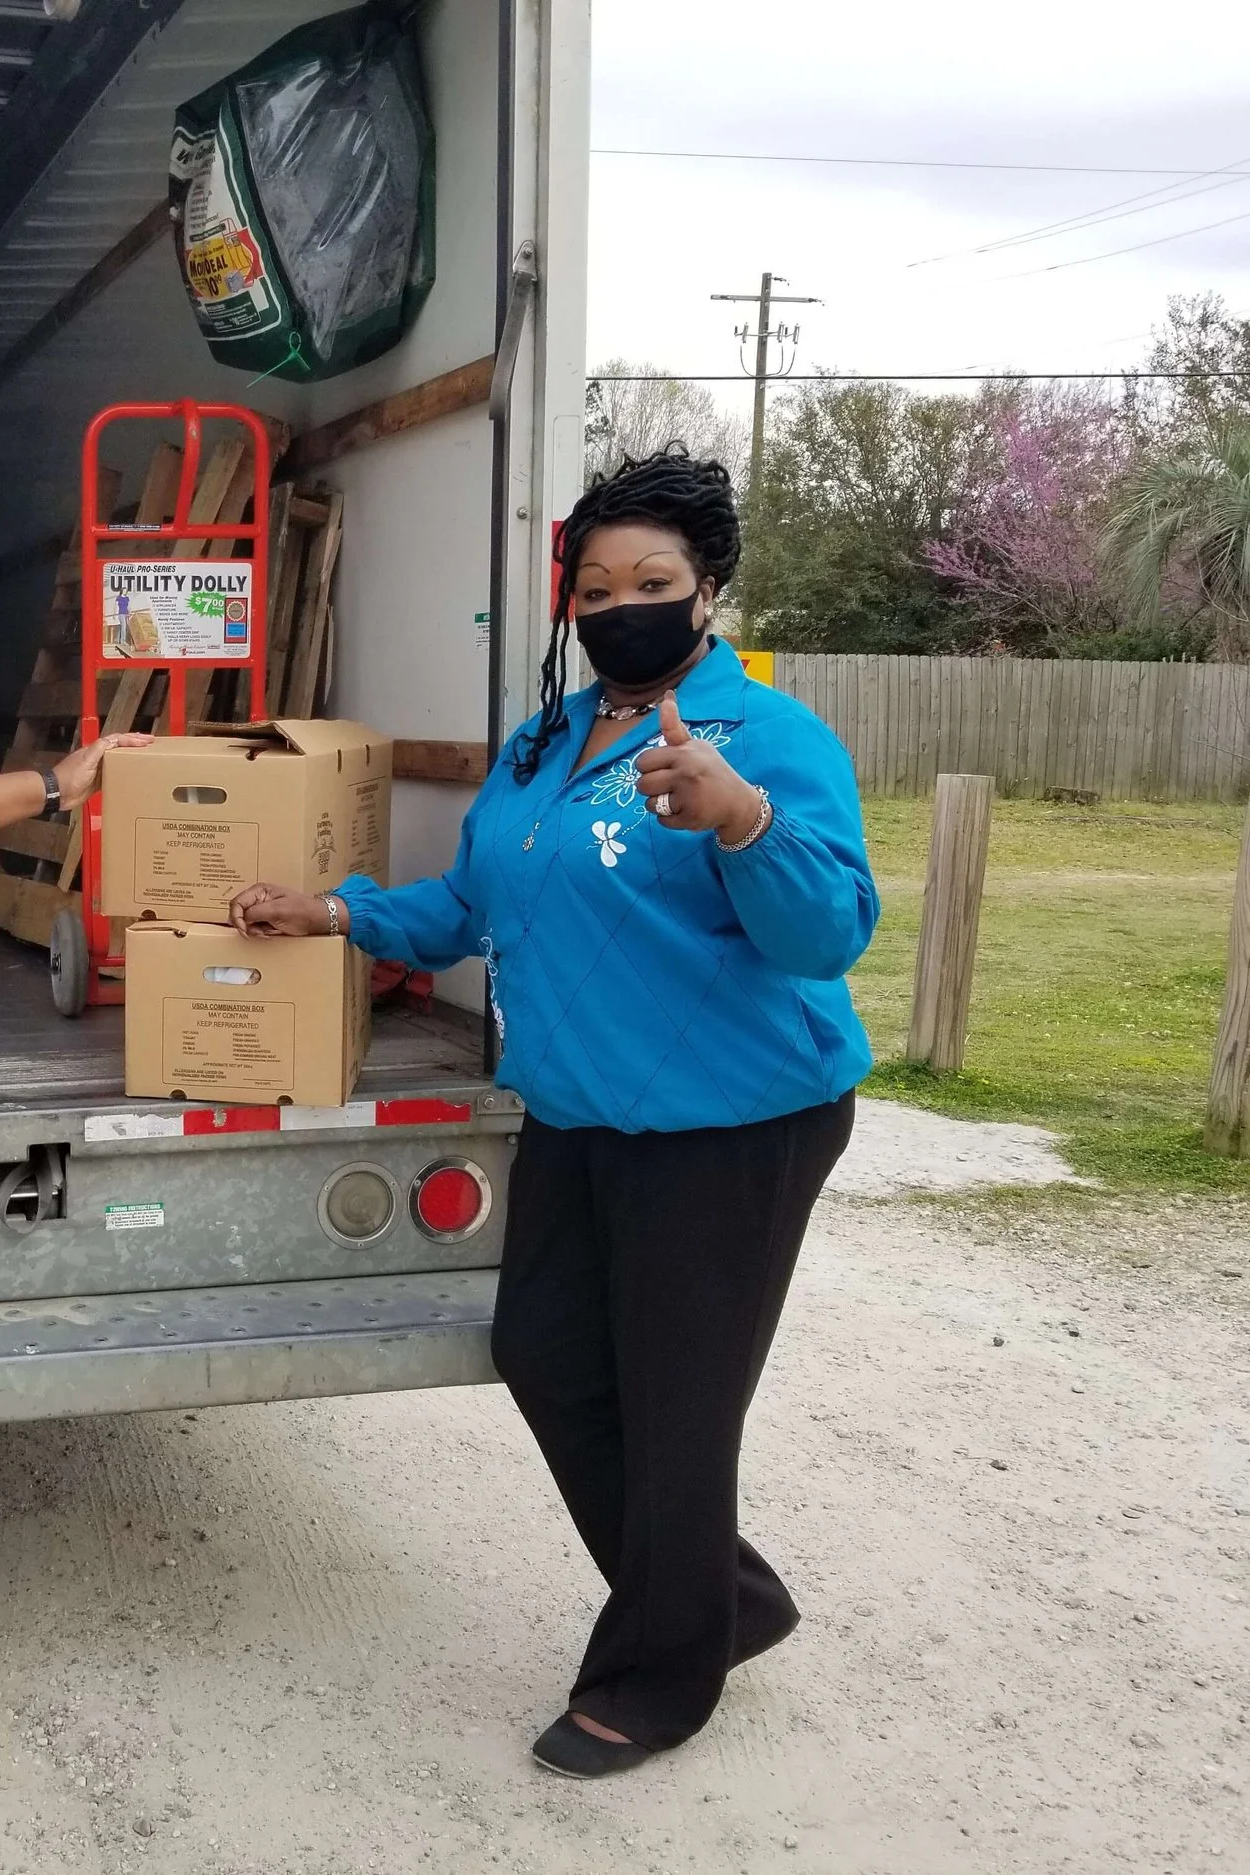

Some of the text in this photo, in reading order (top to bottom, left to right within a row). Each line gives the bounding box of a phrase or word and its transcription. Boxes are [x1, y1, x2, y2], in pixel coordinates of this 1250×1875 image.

[137, 565, 176, 573] PRO-SERIES
[110, 576, 247, 592] UTILITY DOLLY
[182, 841, 225, 849] REFRIGERATED
[210, 1004, 251, 1012] COMBINATION
[252, 1005, 264, 1013] BOX
[214, 1021, 259, 1029] REFRIGERATED
